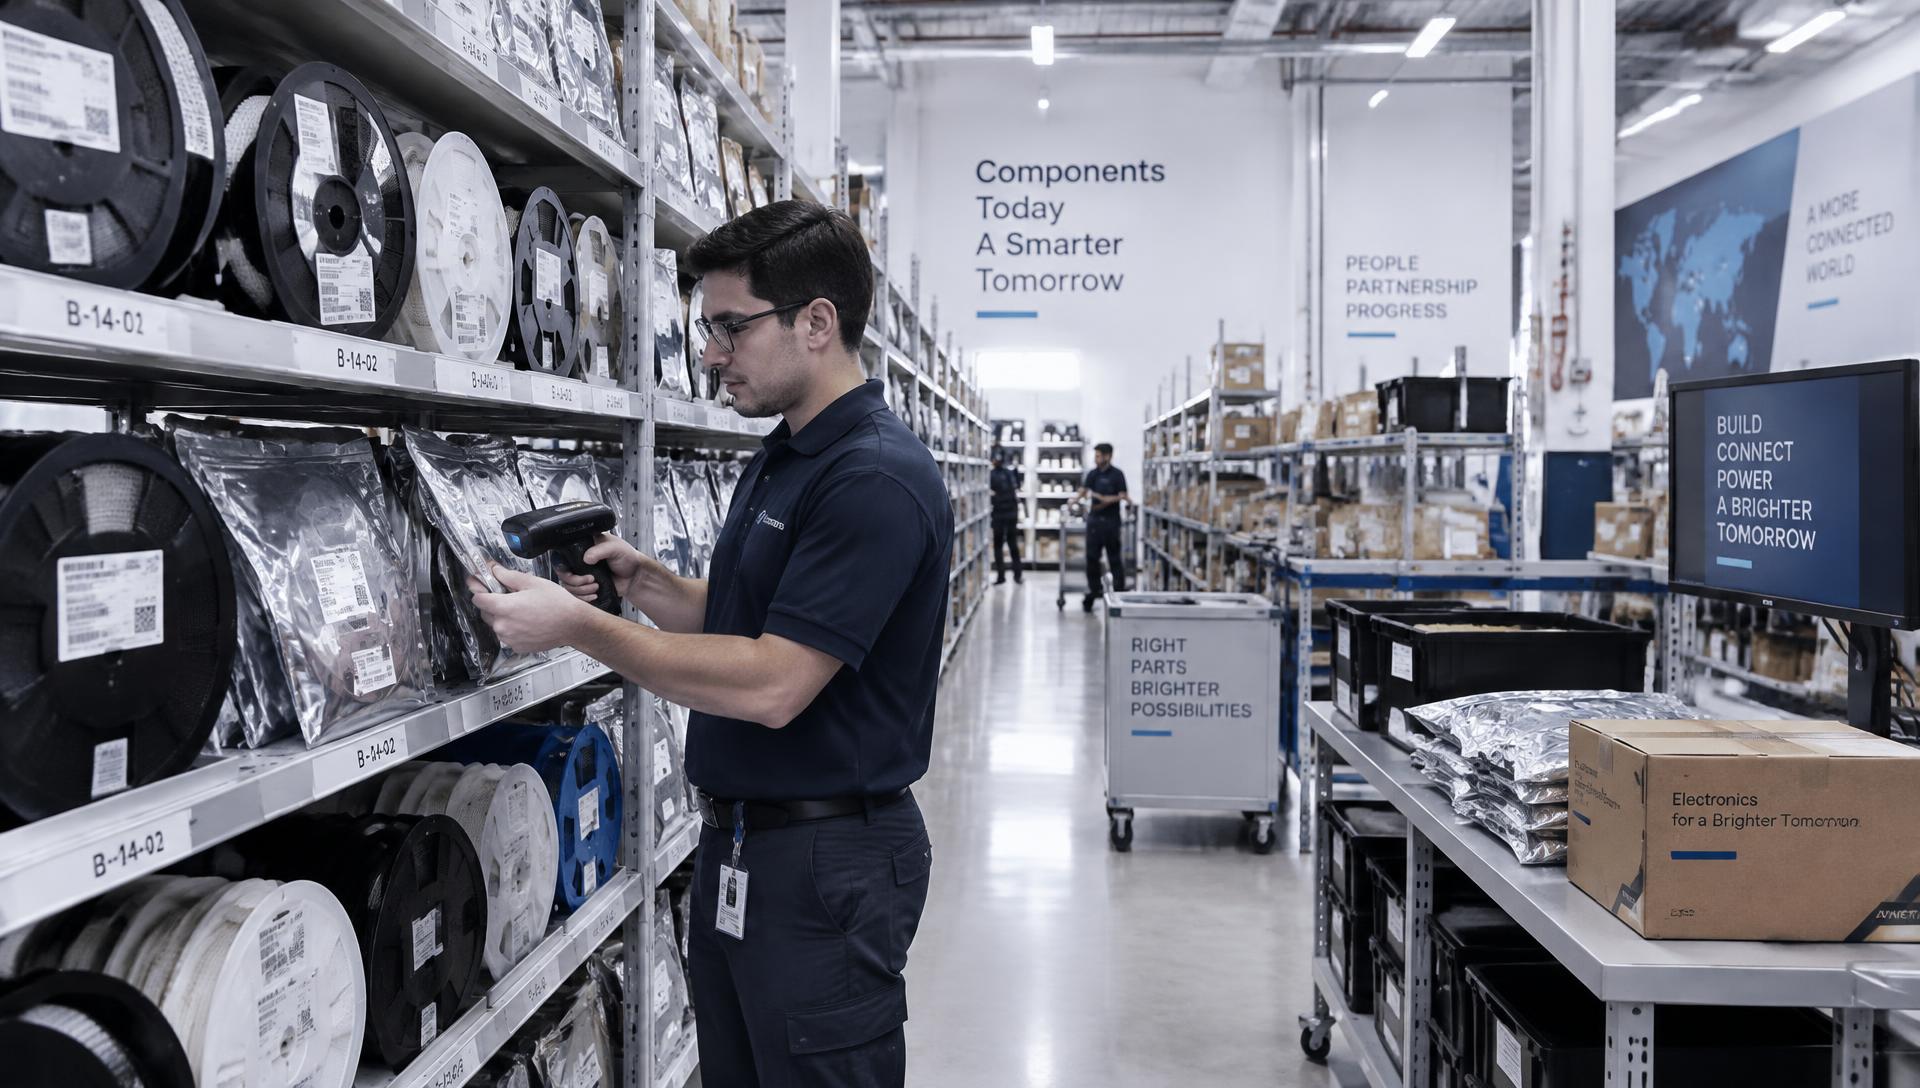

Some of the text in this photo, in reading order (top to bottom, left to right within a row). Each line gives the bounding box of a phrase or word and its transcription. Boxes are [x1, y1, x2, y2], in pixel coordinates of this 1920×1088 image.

[976, 159, 1165, 188] Components
[976, 195, 1065, 225] Today
[1807, 189, 1859, 225] A MORE
[1806, 211, 1894, 254] CONNECTED
[976, 232, 1123, 255] A Smarter
[1346, 255, 1419, 271] PEOPLE
[1806, 253, 1854, 283] WORLD
[976, 267, 1124, 292] Tomorrow
[1346, 279, 1478, 294] PARTNERSHIP
[66, 299, 144, 335] B-14-02
[1346, 302, 1448, 319] PROGRESS
[337, 348, 378, 373] B-14-02
[1717, 414, 1762, 435] BUILD
[1717, 441, 1794, 462] CONNECT
[1717, 469, 1773, 490] POWER
[1716, 495, 1812, 521] A BRIGHTER
[1716, 522, 1816, 551] TOMORROW
[1131, 637, 1188, 653] RIGHT
[1131, 659, 1187, 675] PARTS
[1131, 681, 1220, 697] BRIGHTER
[1131, 702, 1253, 719] POSSIBILITIES
[1672, 792, 1758, 806] Electronics
[1672, 813, 1695, 827] for
[1698, 816, 1707, 827] a
[1712, 813, 1777, 830] Brighter
